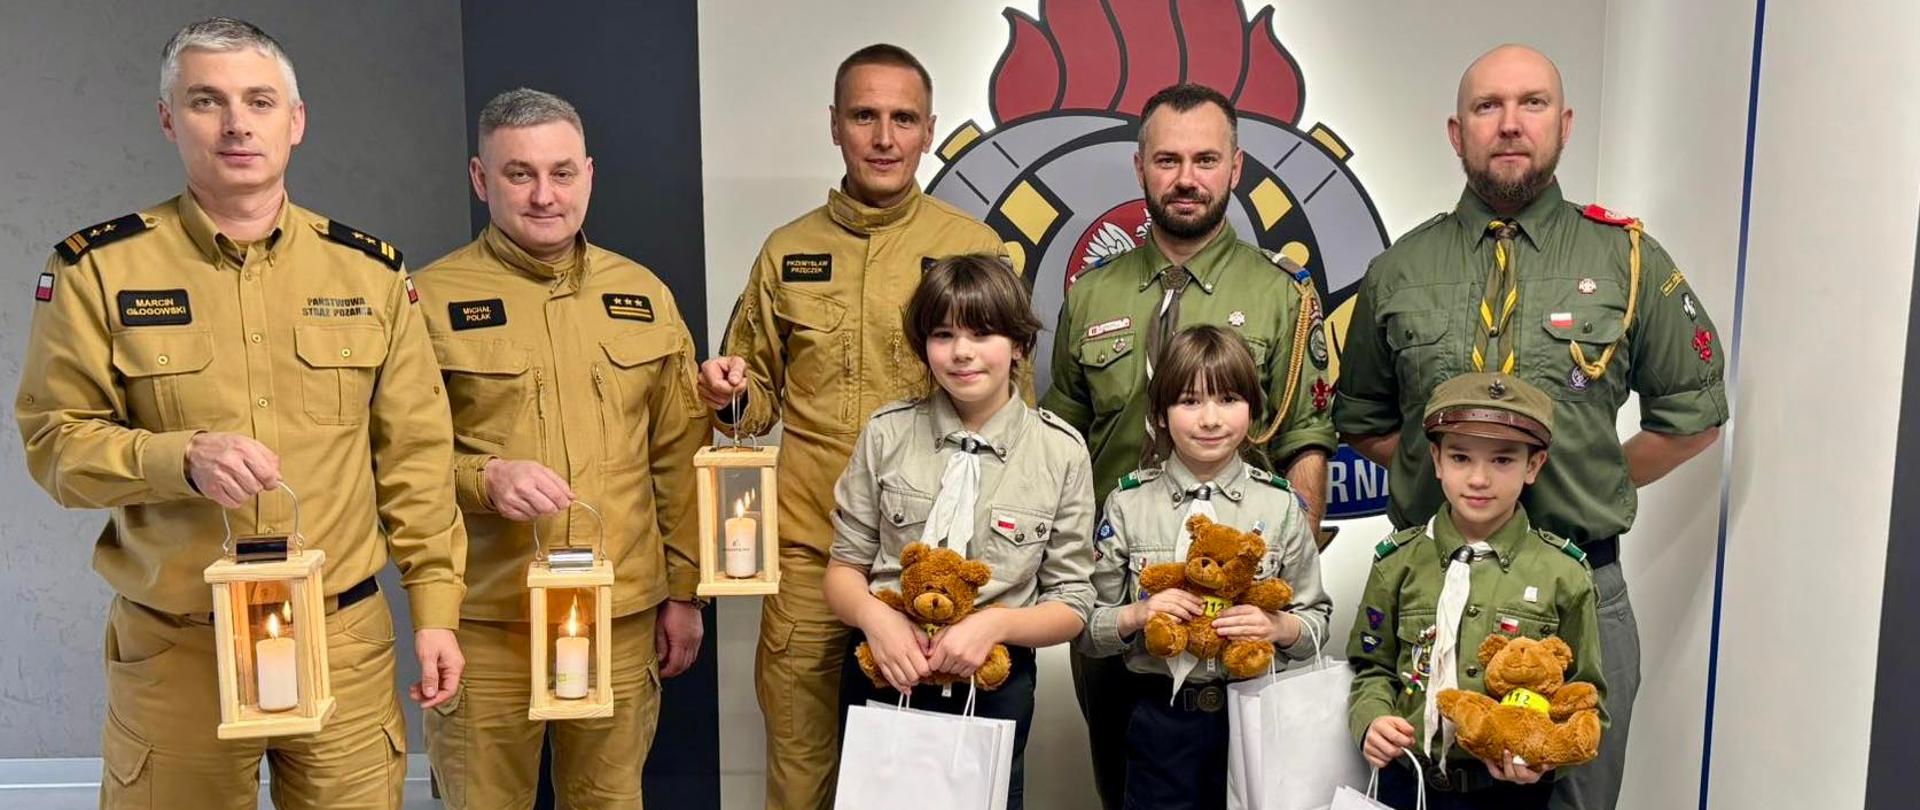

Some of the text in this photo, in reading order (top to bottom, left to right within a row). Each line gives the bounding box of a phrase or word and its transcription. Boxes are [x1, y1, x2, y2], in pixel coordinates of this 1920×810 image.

[135, 298, 174, 307] MARCIN
[126, 306, 186, 316] GŁOGOWSKI
[463, 306, 491, 315] MICHAŁ
[466, 314, 491, 322] POLAK
[1508, 692, 1530, 705] 112
